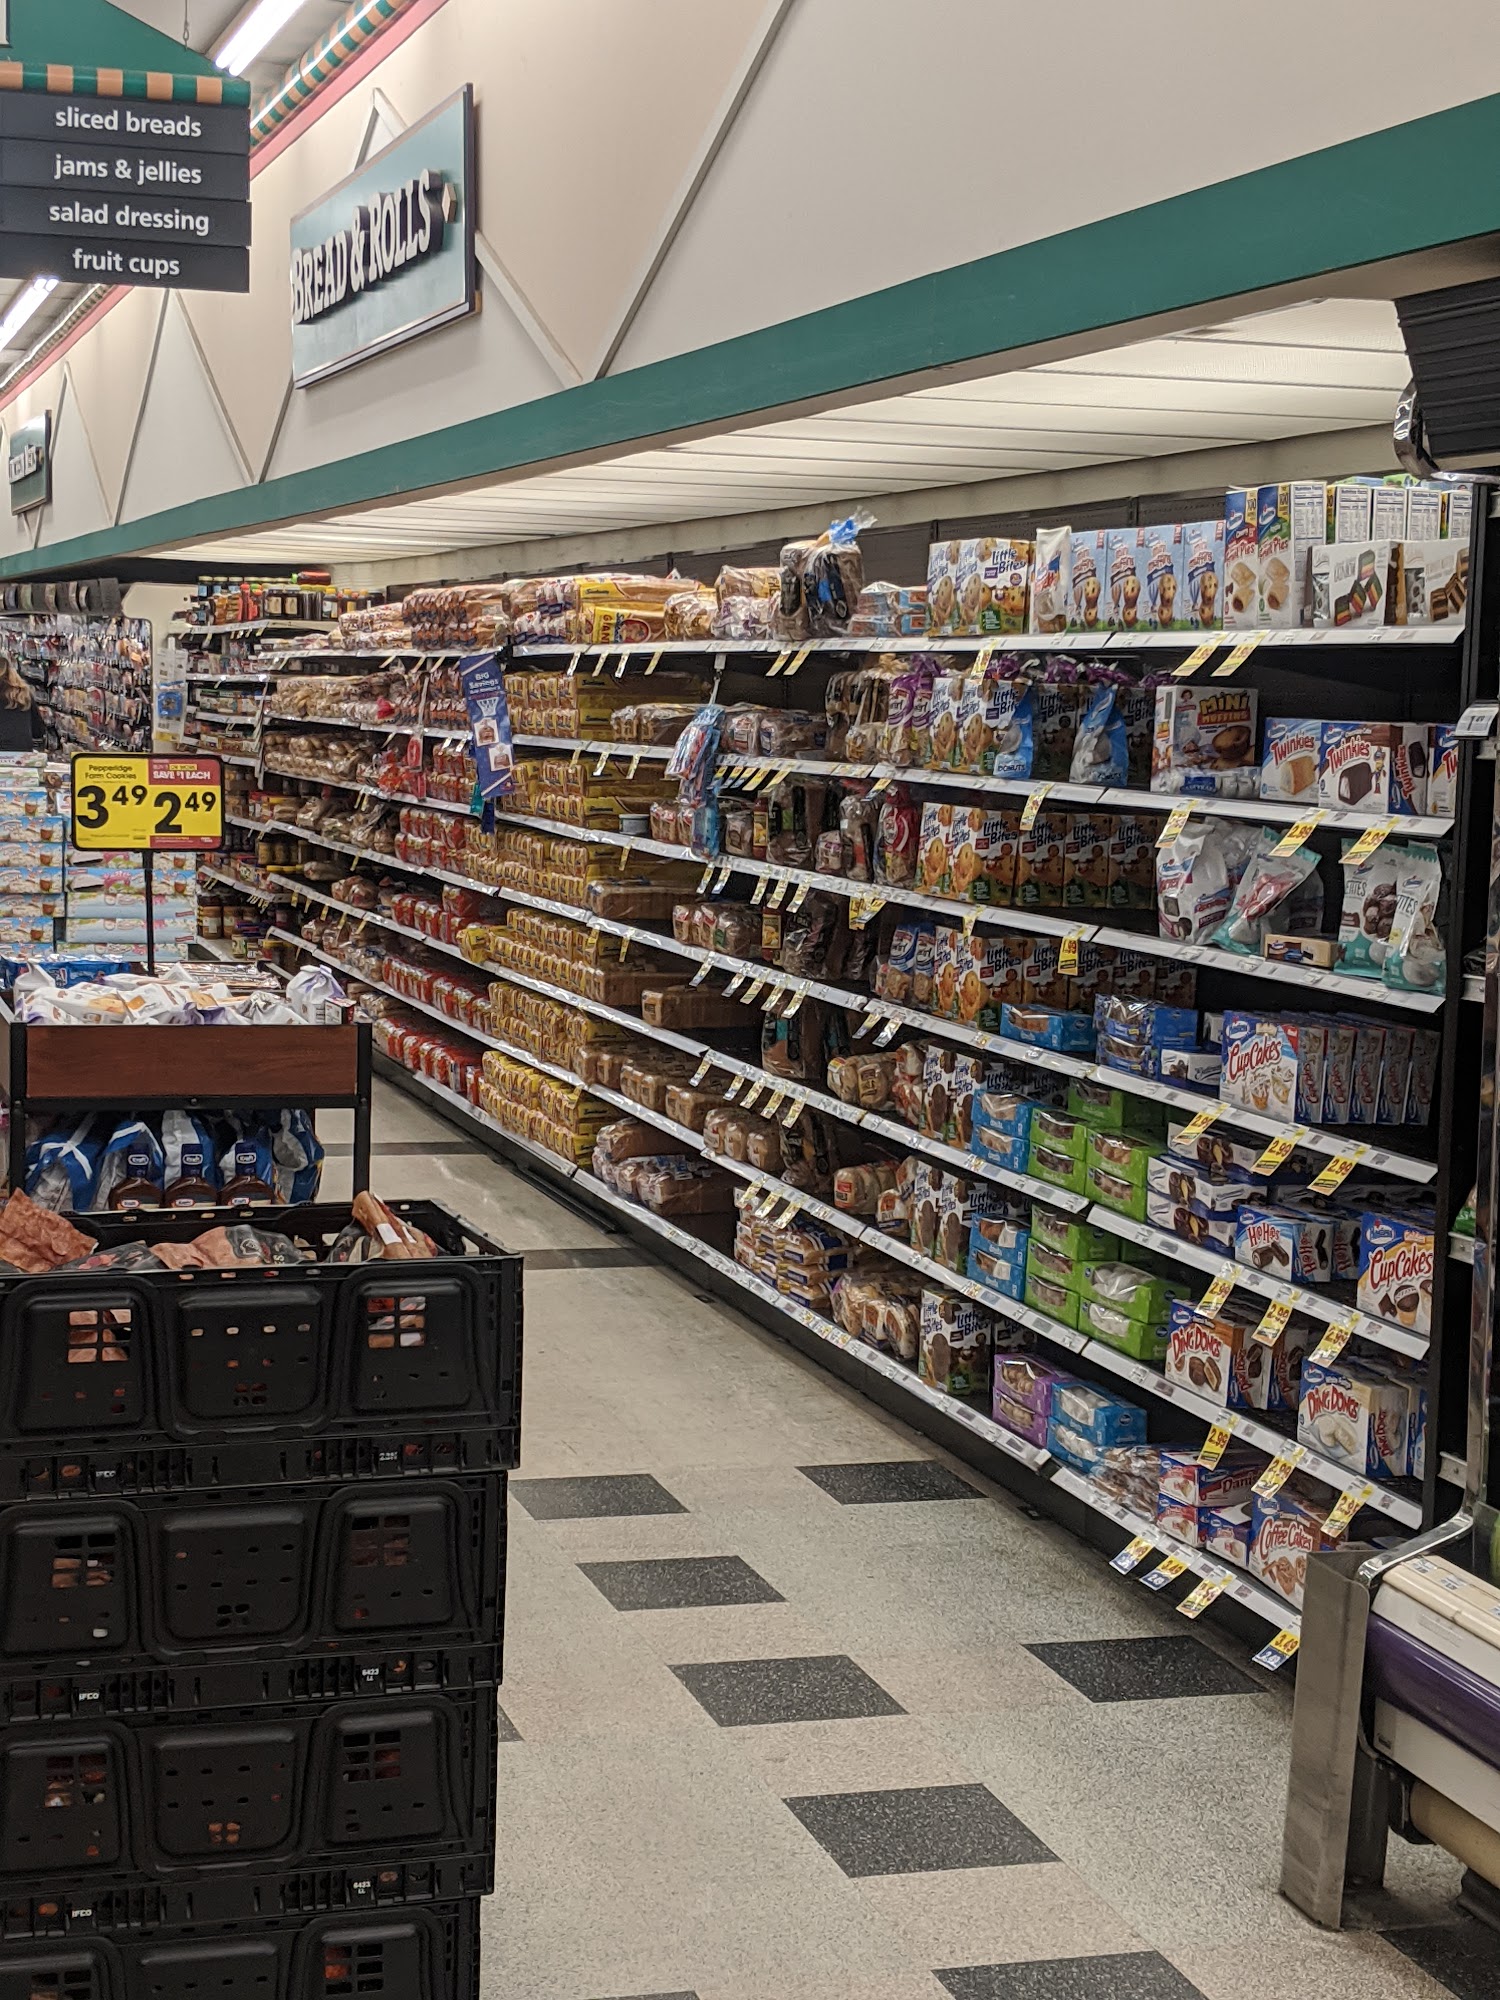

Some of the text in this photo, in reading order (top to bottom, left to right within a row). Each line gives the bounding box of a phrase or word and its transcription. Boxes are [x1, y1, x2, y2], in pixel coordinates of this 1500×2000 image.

[55, 107, 202, 138] sliced breads
[53, 154, 202, 185] jams & jellies
[49, 203, 210, 237] salad dressing
[291, 168, 433, 325] BREAD & ROLLS
[72, 248, 180, 280] fruit cups
[992, 549, 1018, 566] Little
[998, 560, 1025, 574] Bites
[600, 613, 613, 644] GIAN
[1000, 701, 1018, 714] Bit
[1270, 732, 1316, 768] Twinkies
[1326, 736, 1372, 776] Twinkies
[88, 764, 133, 772] Pepperidge
[106, 772, 137, 780] Cookies
[76, 784, 148, 830] 3 49
[153, 791, 217, 834] 2 49
[983, 818, 1009, 837] Little
[1288, 823, 1314, 840] 2.99
[990, 831, 1018, 845] Bites
[1037, 833, 1065, 848] Bites
[1081, 834, 1109, 848] Bites
[1360, 831, 1388, 847] 2.99
[994, 957, 1021, 972] Bites
[1229, 1036, 1282, 1081] CupCakes
[1267, 1139, 1292, 1158] 2.99
[1327, 1158, 1354, 1176] 2.99
[1370, 1245, 1433, 1290] CupCakes
[1208, 1428, 1230, 1449] 2.99
[1222, 1472, 1252, 1493] Dani
[1260, 1516, 1288, 1560] Coffee
[1274, 1633, 1299, 1653] 3.49
